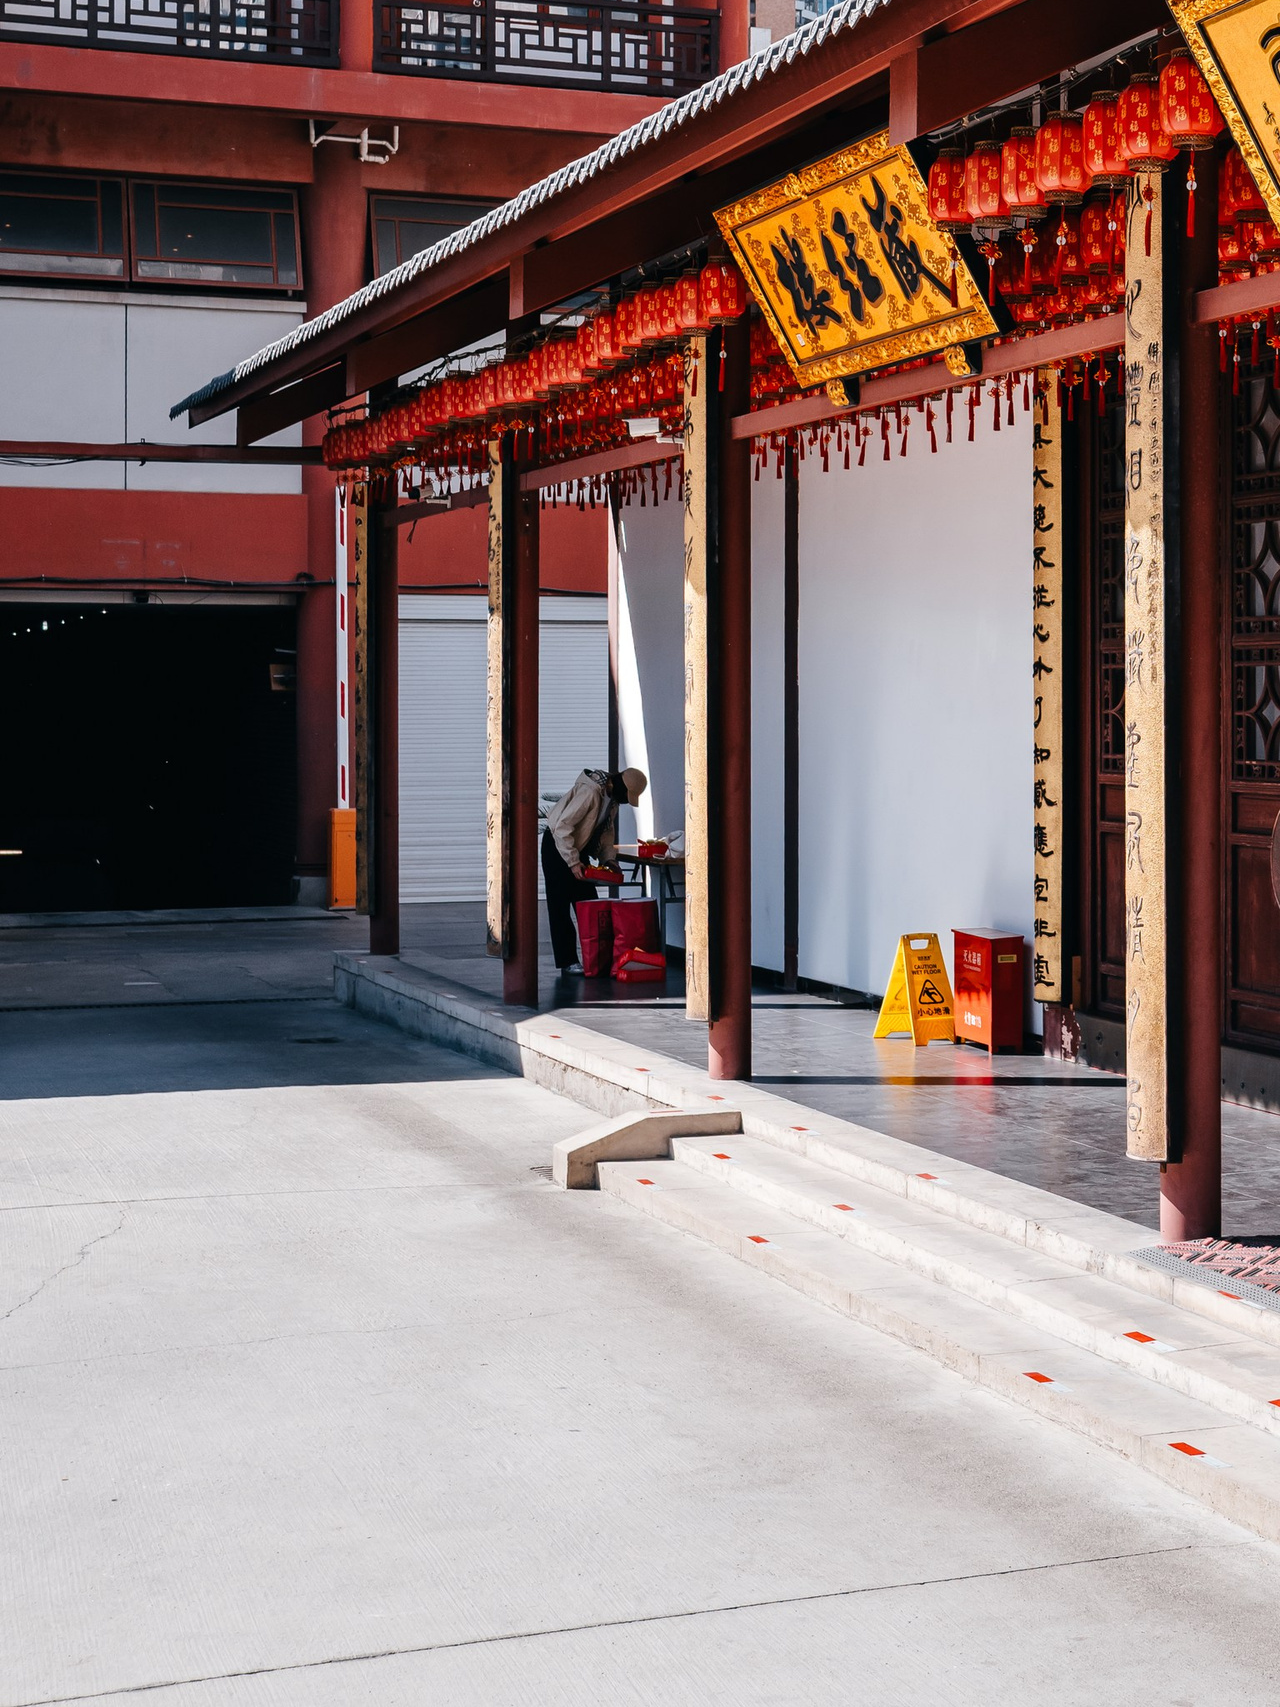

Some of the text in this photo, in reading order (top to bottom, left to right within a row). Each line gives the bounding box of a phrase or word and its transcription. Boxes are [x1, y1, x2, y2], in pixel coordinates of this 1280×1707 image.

[1174, 76, 1186, 92] 福
[1136, 103, 1148, 118] 福
[1175, 106, 1188, 122] 福
[1197, 108, 1210, 124] 福
[1136, 132, 1149, 149] 福
[1157, 132, 1169, 147] 福
[1068, 166, 1081, 180] 福
[1024, 181, 1037, 197] 福
[987, 192, 999, 207] 福
[917, 1006, 951, 1017] 小心地滑
